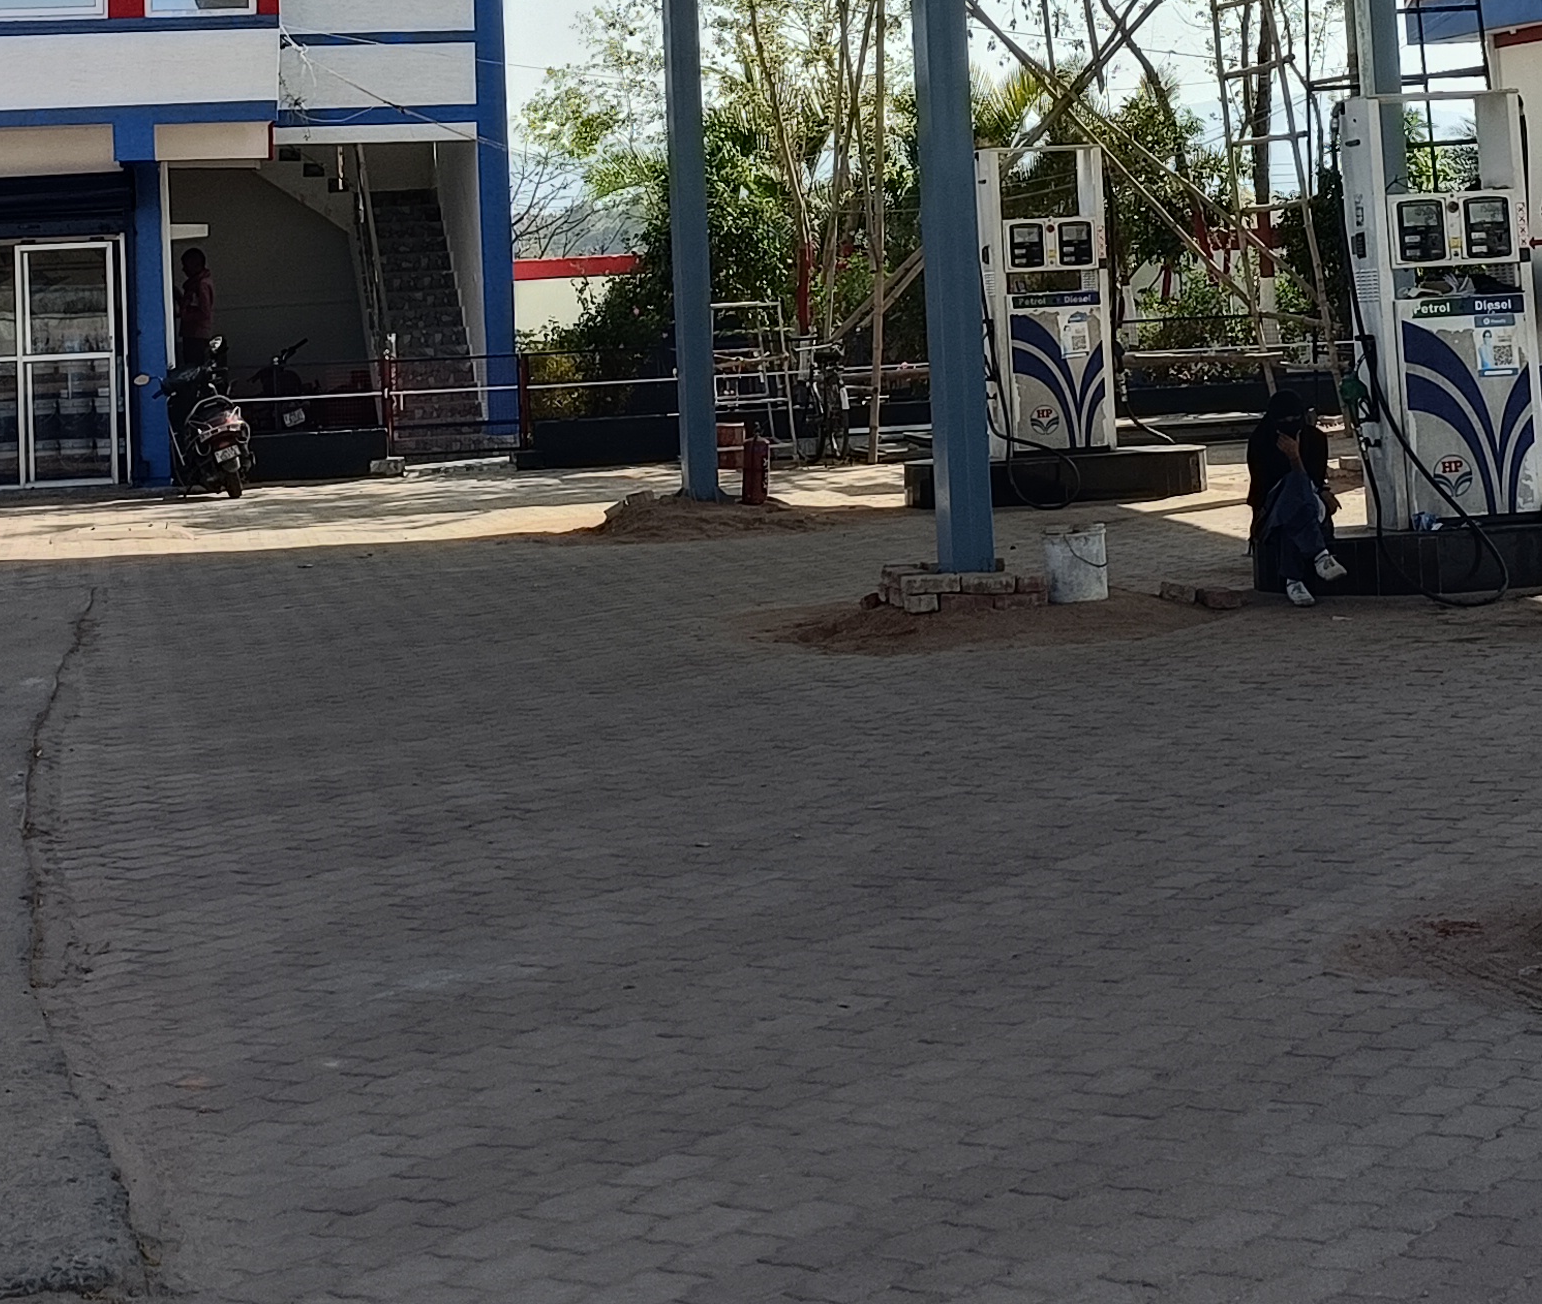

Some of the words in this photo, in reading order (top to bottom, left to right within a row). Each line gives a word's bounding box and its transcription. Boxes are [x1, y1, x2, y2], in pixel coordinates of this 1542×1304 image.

[1019, 297, 1047, 306] Petrol
[1064, 294, 1092, 304] Diesel
[1474, 298, 1512, 311] Diesel
[1036, 408, 1053, 419] HP
[1441, 460, 1464, 474] HP
